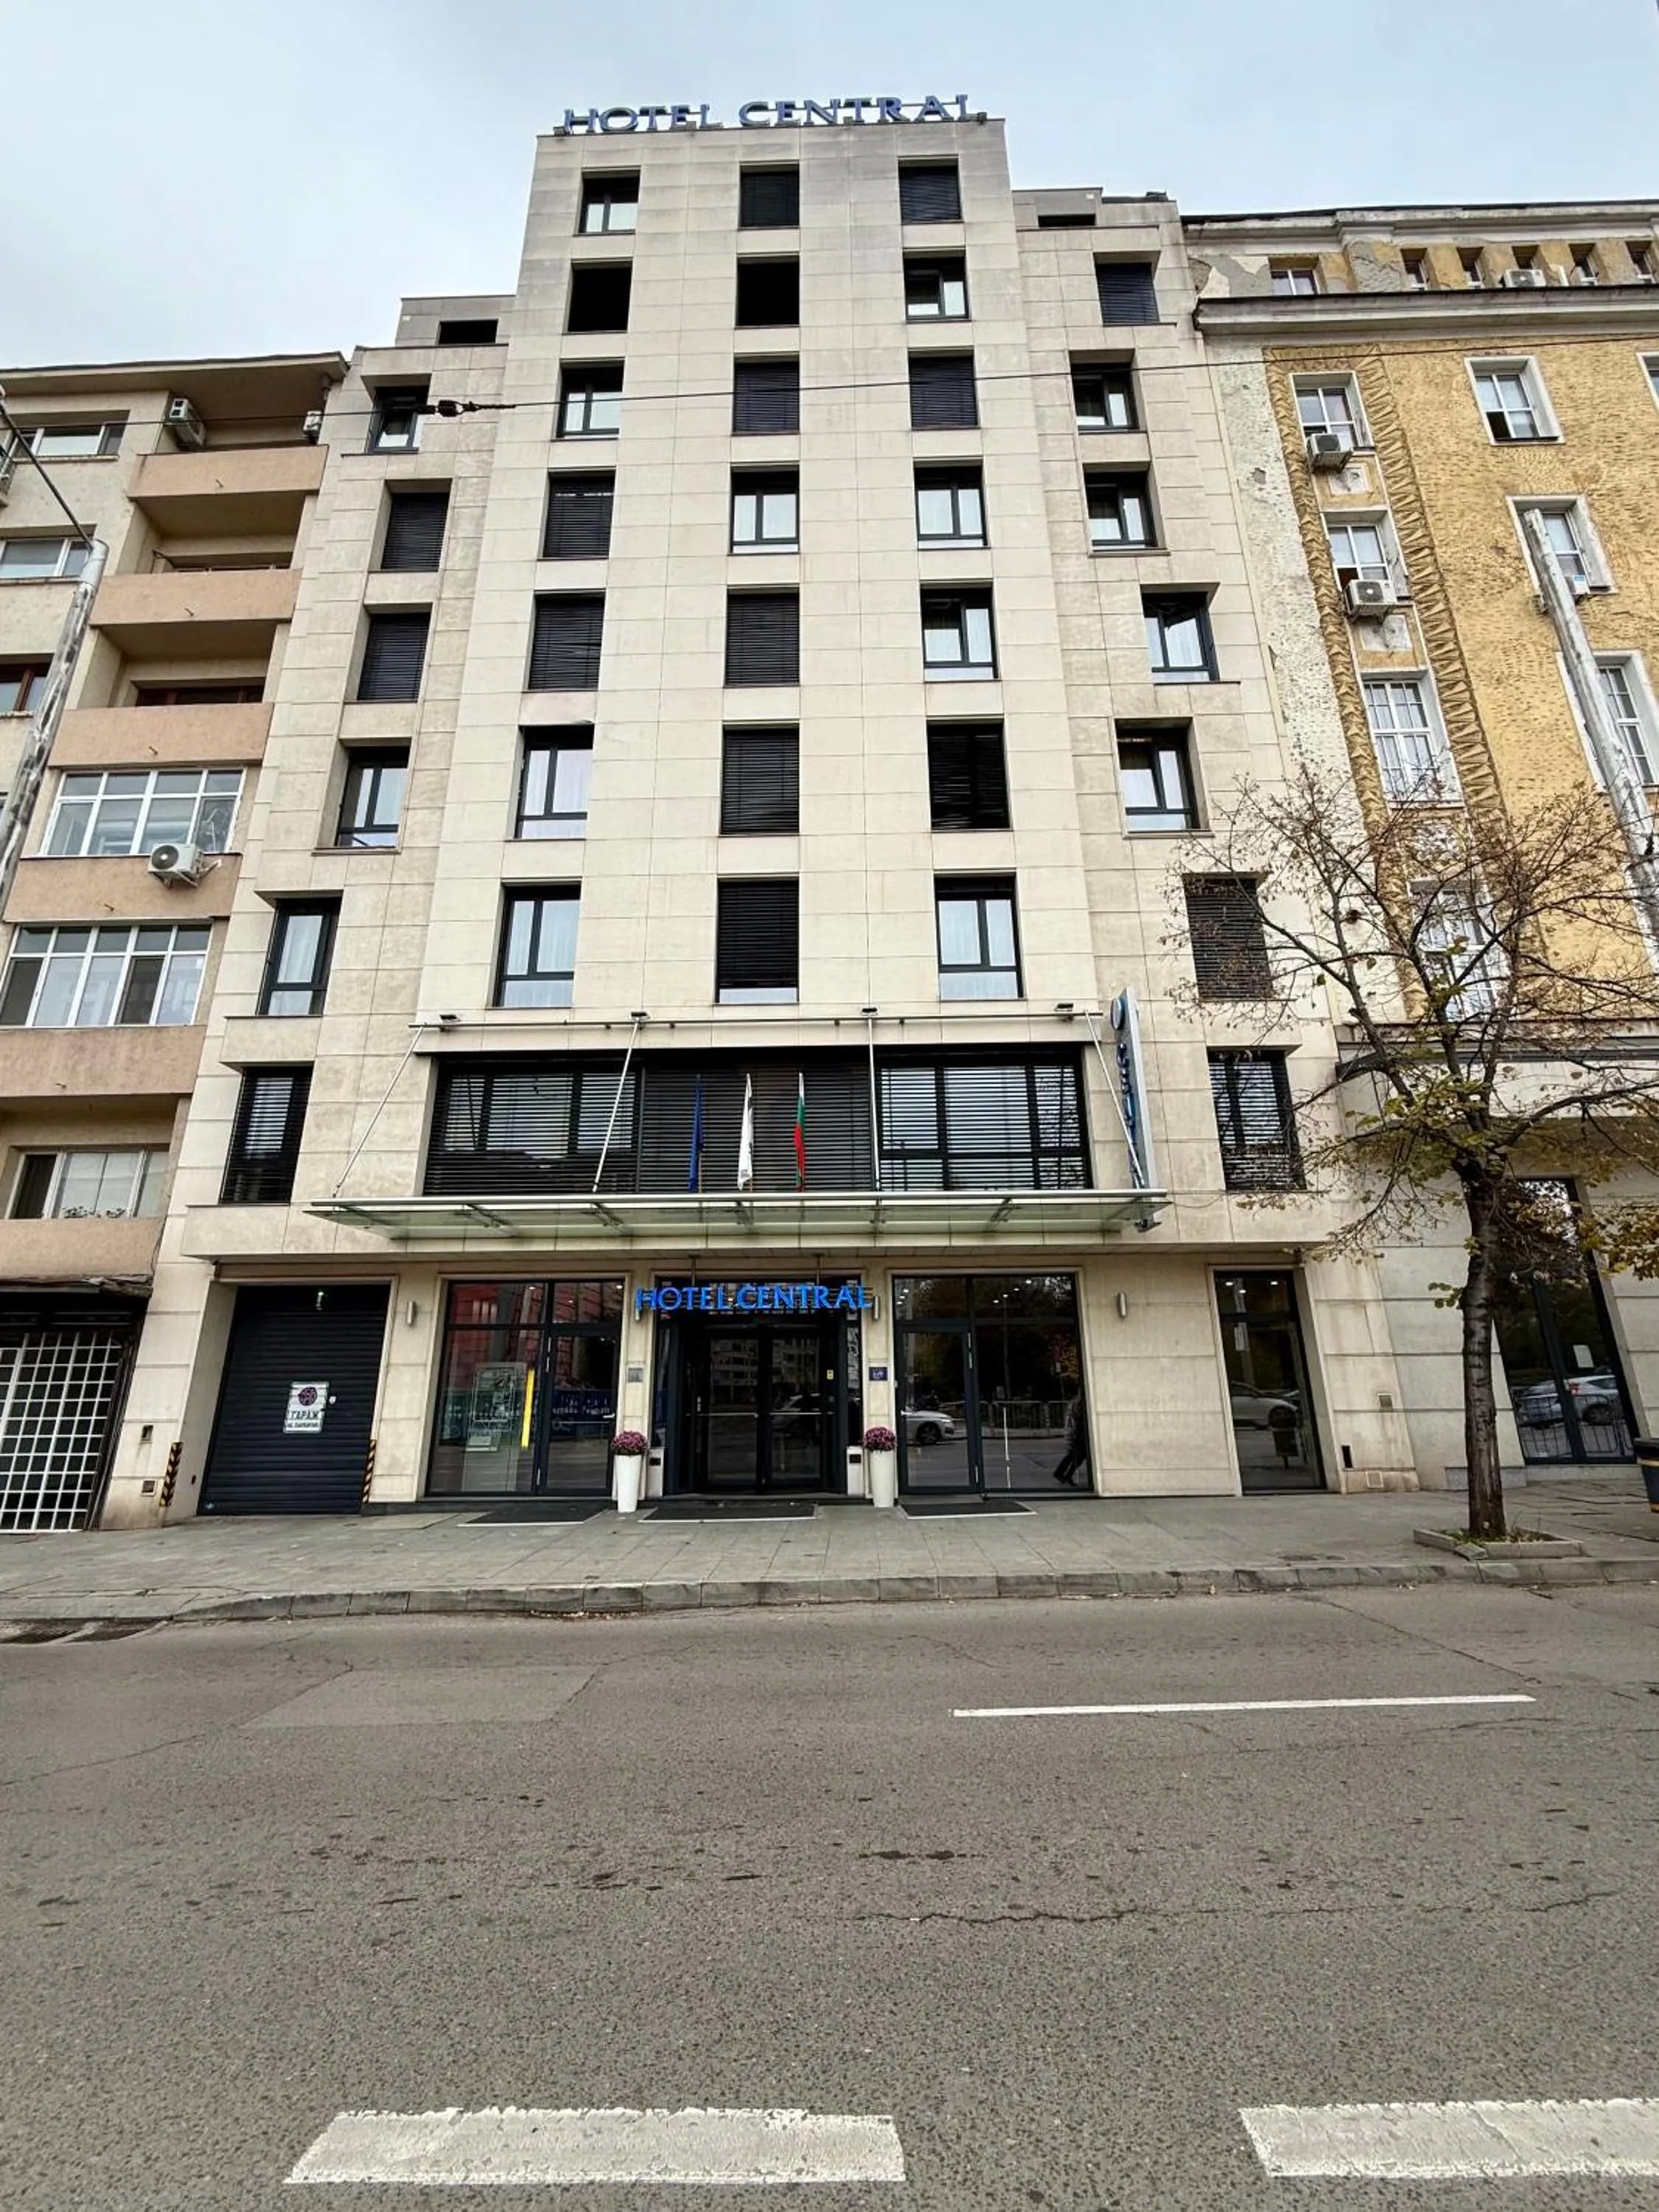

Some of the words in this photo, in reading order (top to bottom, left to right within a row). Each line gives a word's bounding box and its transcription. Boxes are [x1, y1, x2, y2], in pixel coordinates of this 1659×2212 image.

[564, 104, 723, 135] HOTEL
[738, 94, 982, 126] CENTRAL
[636, 1286, 732, 1310] HOTEL
[737, 1284, 874, 1310] CENTRAL
[291, 1411, 320, 1420] ГАРАЖ
